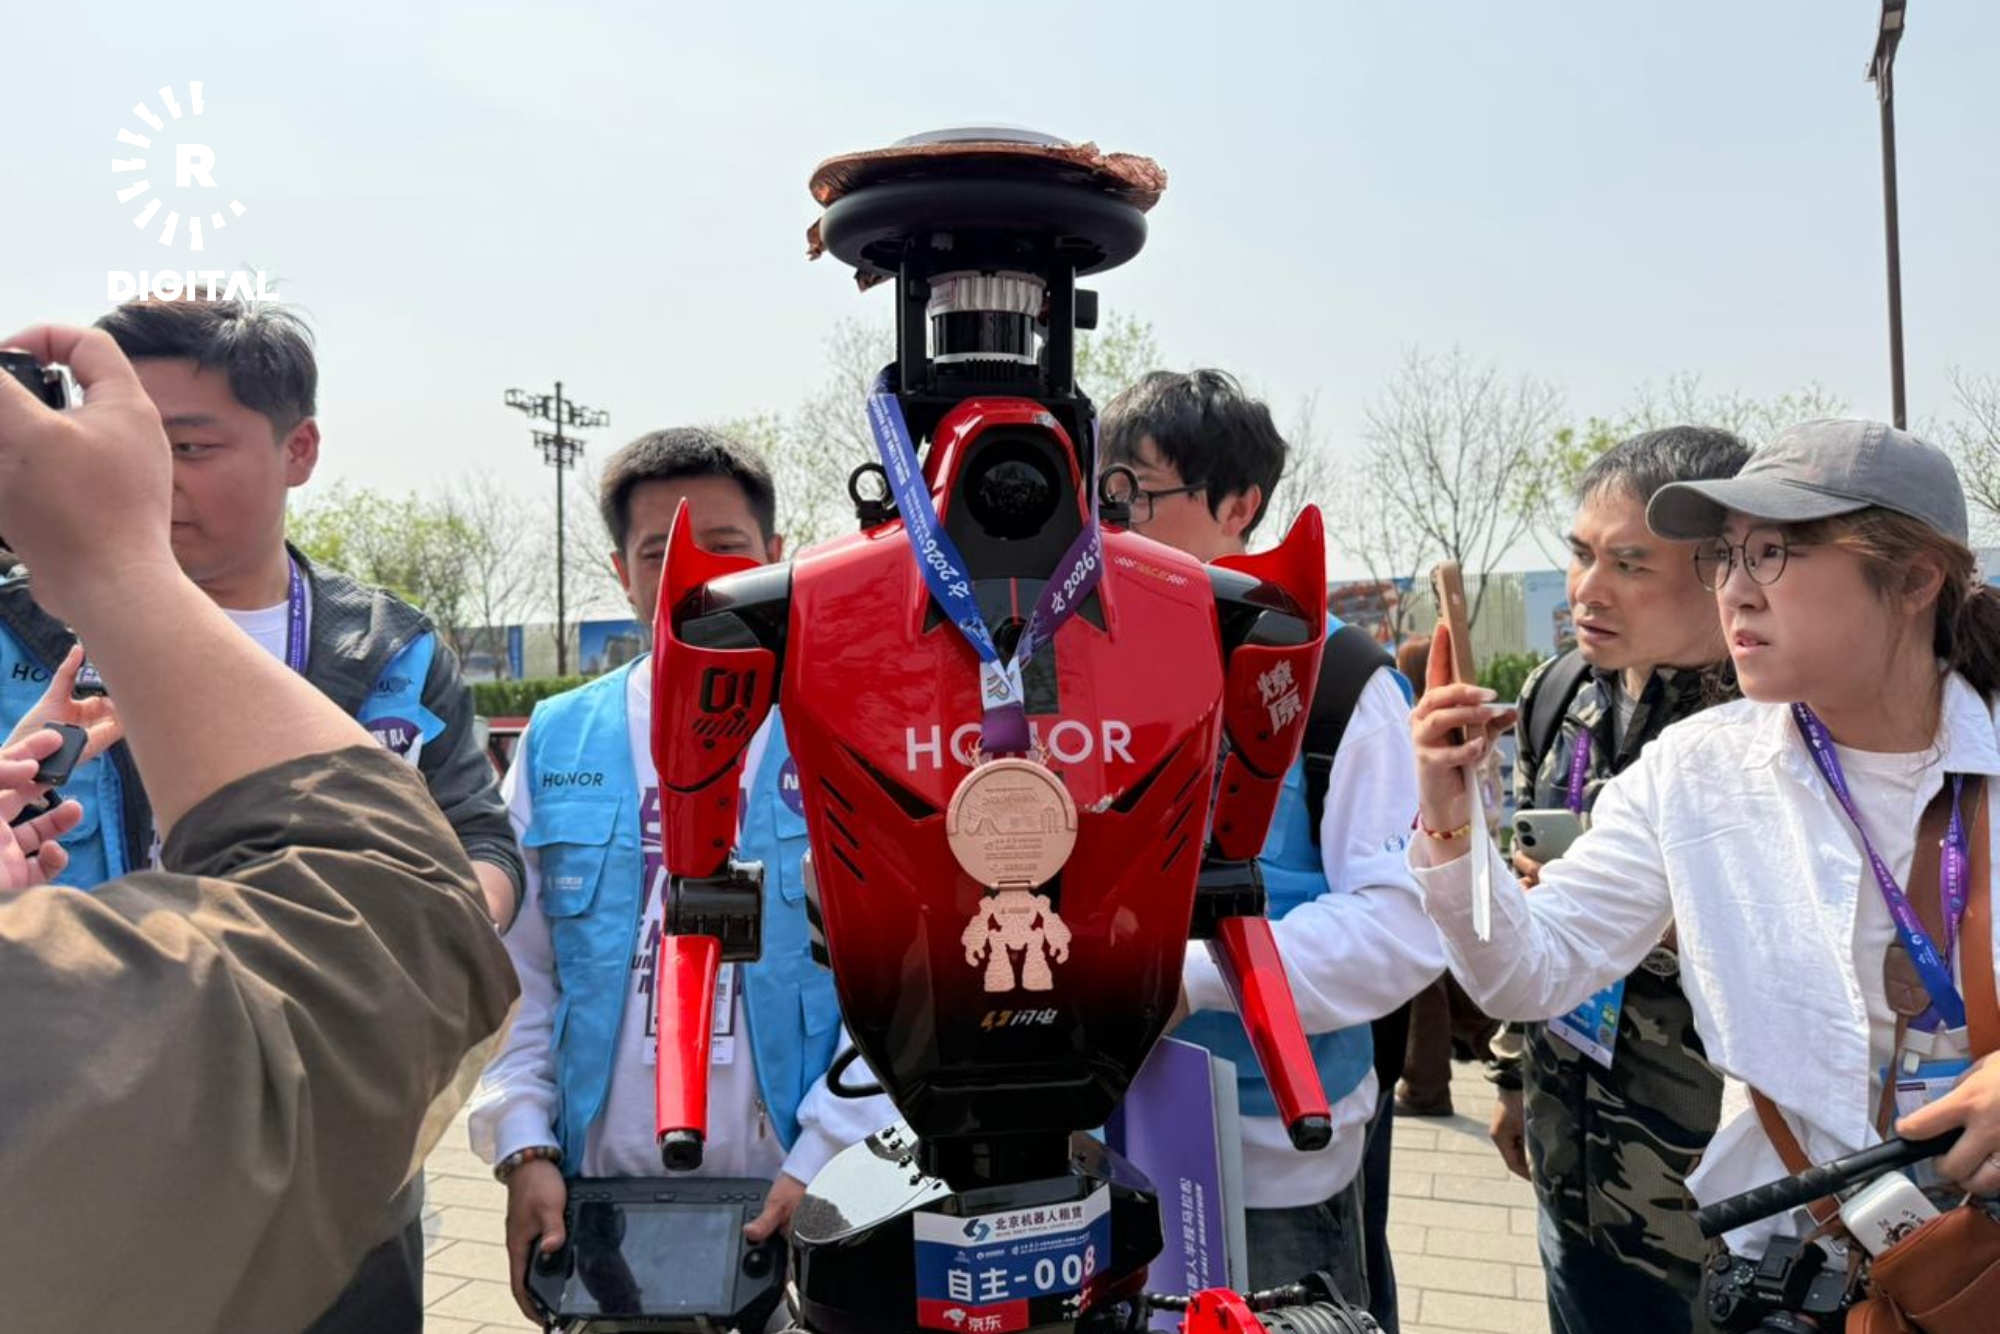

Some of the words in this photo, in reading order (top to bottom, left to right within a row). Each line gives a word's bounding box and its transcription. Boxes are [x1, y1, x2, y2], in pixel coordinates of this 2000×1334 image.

[925, 537, 960, 582] 2026
[1062, 553, 1095, 599] 2026
[1256, 659, 1303, 736] 燎原
[542, 772, 605, 788] HONOR
[1010, 1007, 1059, 1026] 闪电
[995, 1206, 1083, 1230] 北京机器人租赁
[1180, 1177, 1199, 1297] 器人半程马拉松
[947, 1244, 1096, 1303] 自主-008
[968, 1314, 1003, 1333] 京东
